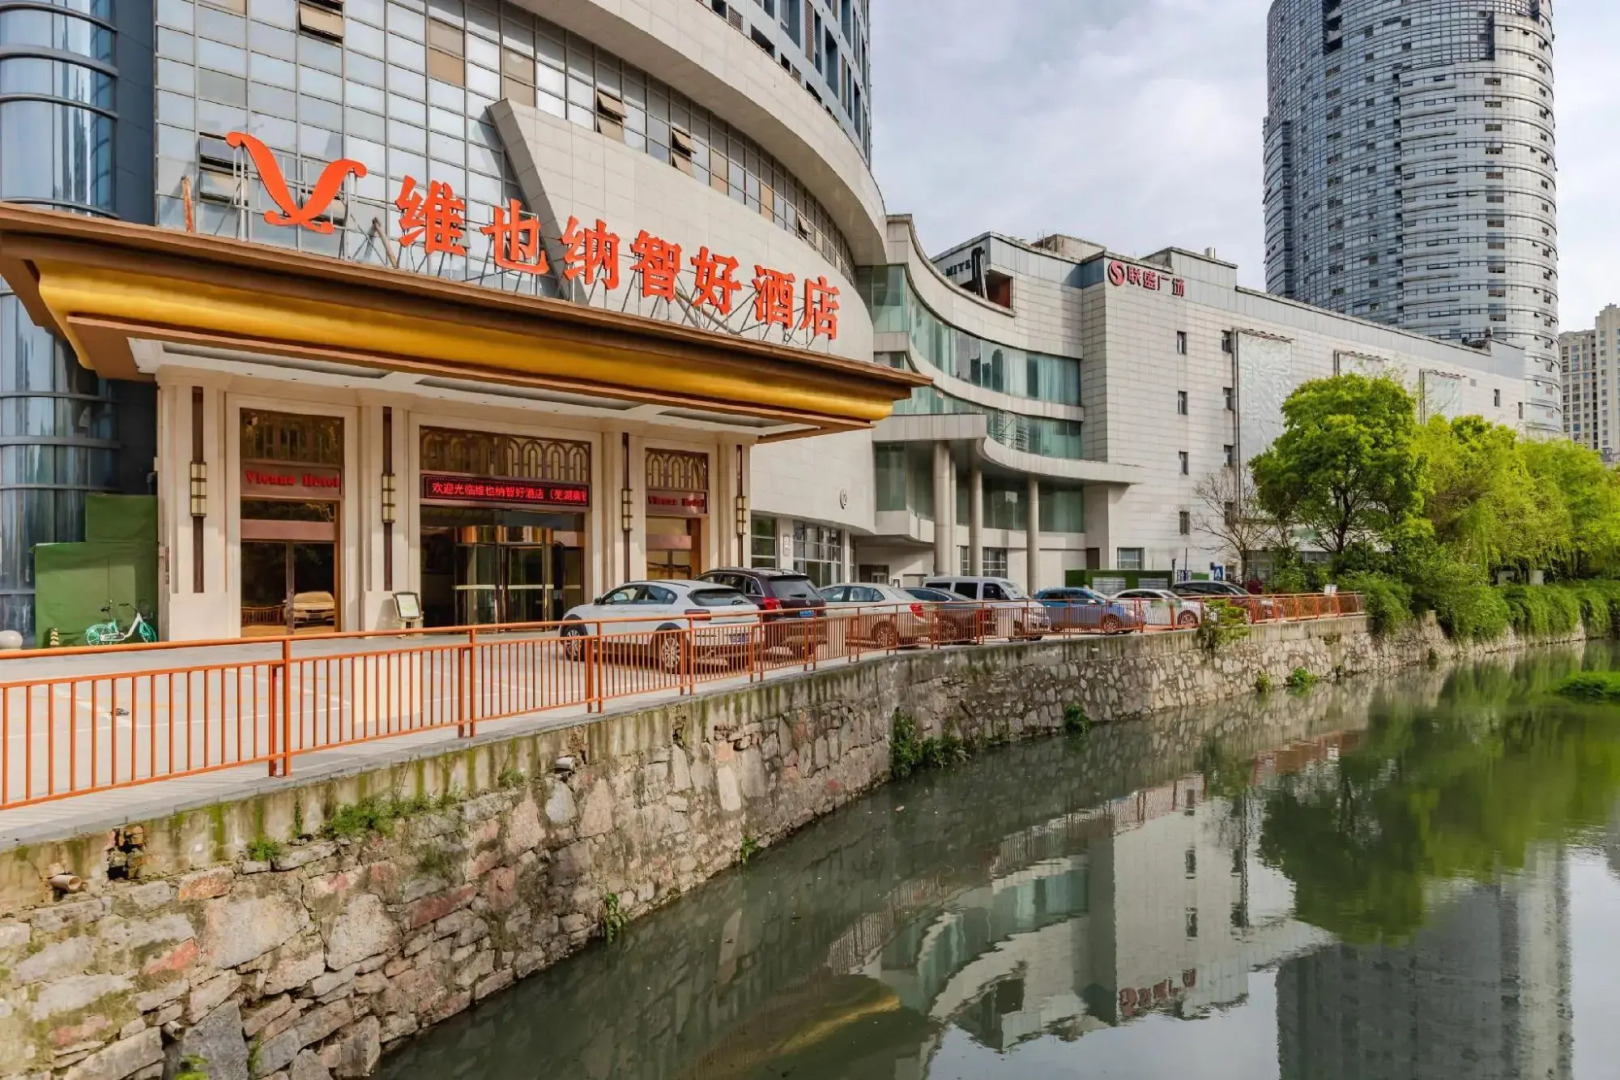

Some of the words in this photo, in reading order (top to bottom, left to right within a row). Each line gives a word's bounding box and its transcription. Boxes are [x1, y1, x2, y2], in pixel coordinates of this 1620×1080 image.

[396, 175, 840, 340] 维也纳智好酒店
[1126, 265, 1185, 298] 联盛广场
